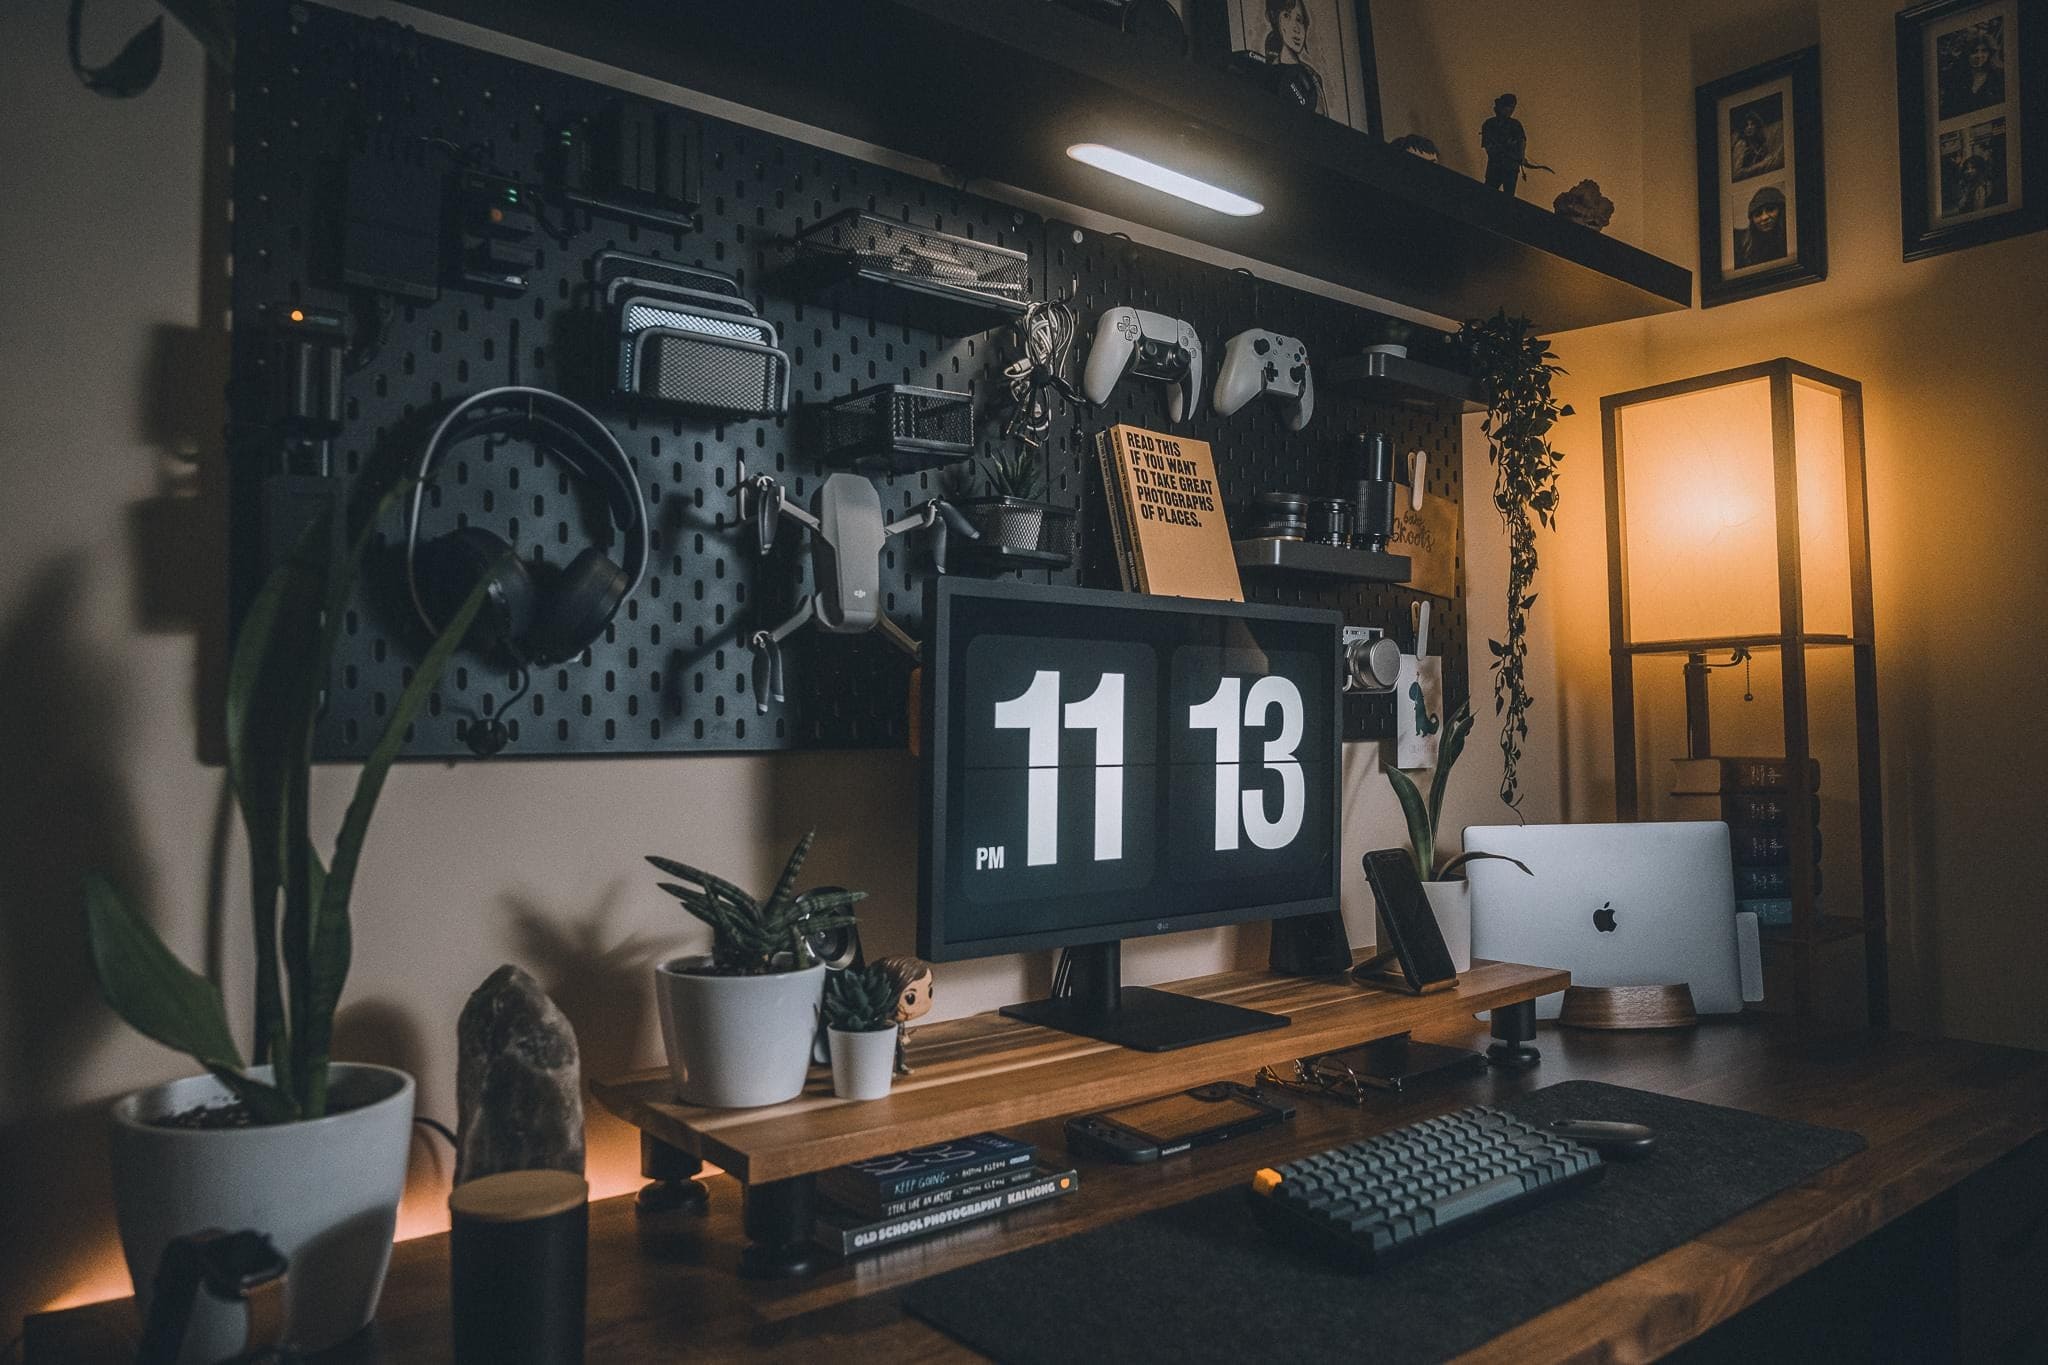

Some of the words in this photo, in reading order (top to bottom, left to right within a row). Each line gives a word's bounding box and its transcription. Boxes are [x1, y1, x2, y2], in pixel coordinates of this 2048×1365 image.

[1126, 432, 1155, 452] READ
[1155, 439, 1181, 457] THIS
[1129, 449, 1141, 466] IF
[1143, 451, 1165, 471] YOU
[1166, 457, 1197, 477] WANT
[1133, 467, 1149, 485] TO
[1149, 470, 1178, 491] TAKE
[1178, 476, 1213, 495] GREAT
[1136, 485, 1215, 513] PHOTOGRAPHS
[1140, 503, 1155, 521] OF
[1156, 506, 1203, 528] PLACES.
[995, 670, 1125, 867] 11
[1189, 675, 1305, 851] 13
[976, 845, 1005, 870] PM
[894, 1179, 916, 1195] KEEP
[854, 1230, 878, 1248] OLD
[878, 1218, 924, 1241] SCHOOL
[923, 1196, 1003, 1229] PHOTOGRAPHY
[1007, 1191, 1026, 1205] KAI
[1025, 1182, 1056, 1199] WONG
